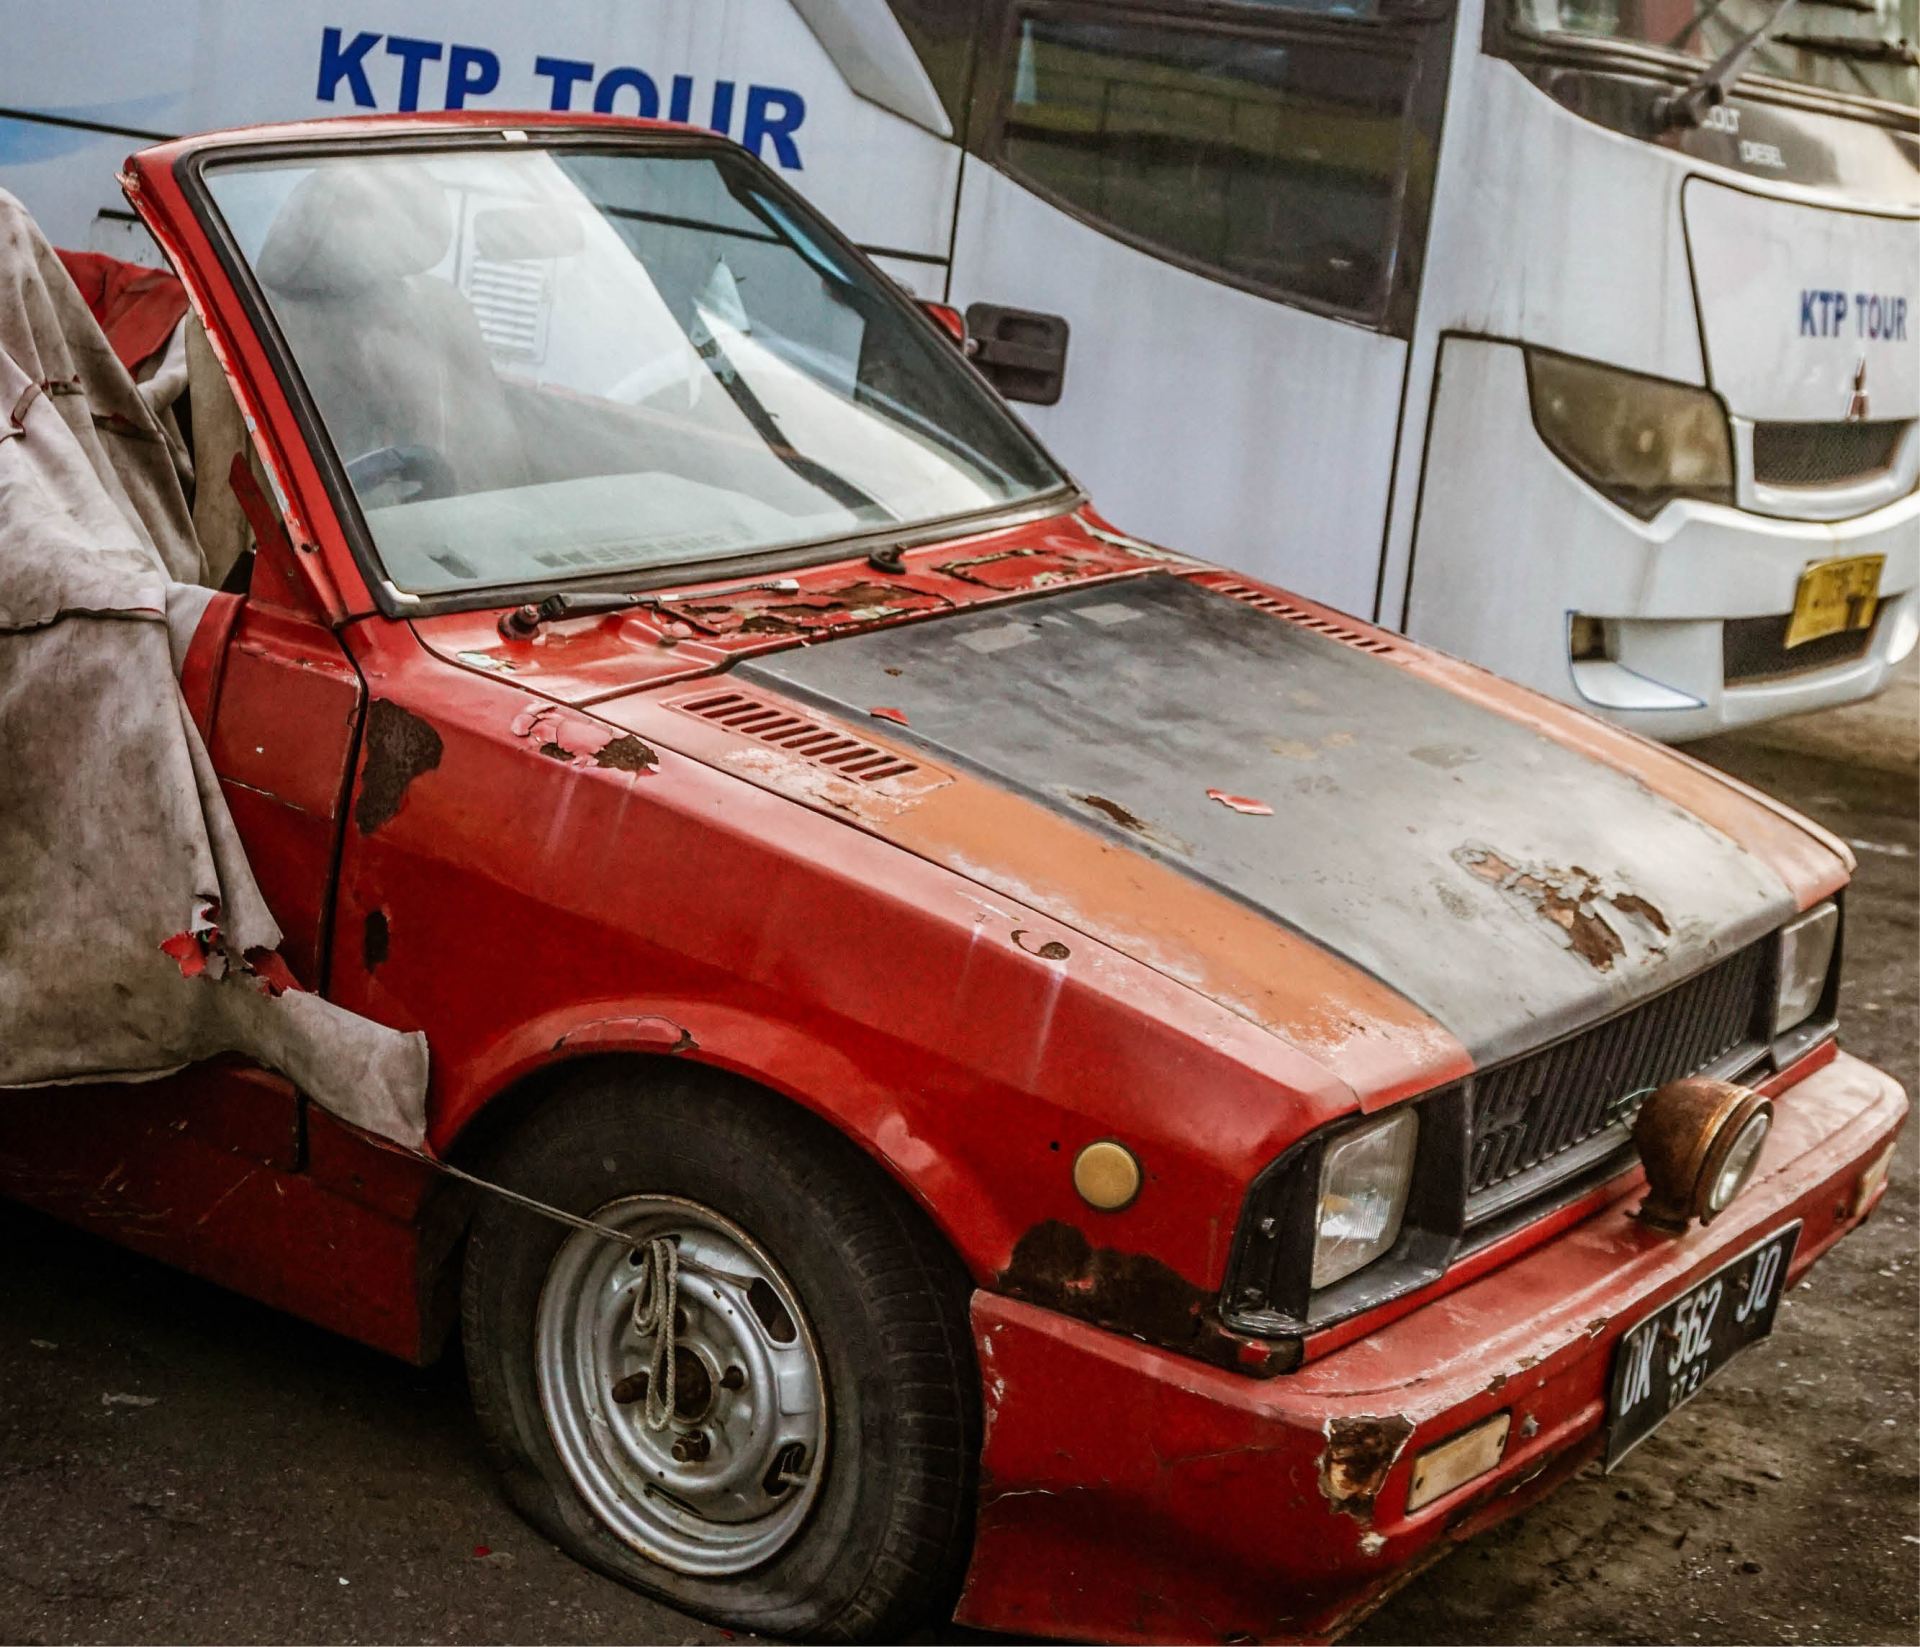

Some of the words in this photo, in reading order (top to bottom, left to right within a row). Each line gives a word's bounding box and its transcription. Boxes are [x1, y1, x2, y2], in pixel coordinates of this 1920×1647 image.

[316, 27, 500, 111] KTP
[534, 55, 806, 171] TOUR
[1800, 289, 1847, 337] KTP
[1855, 293, 1907, 341] TOUR
[1620, 1320, 1660, 1416] DK
[1668, 1279, 1723, 1376] 562
